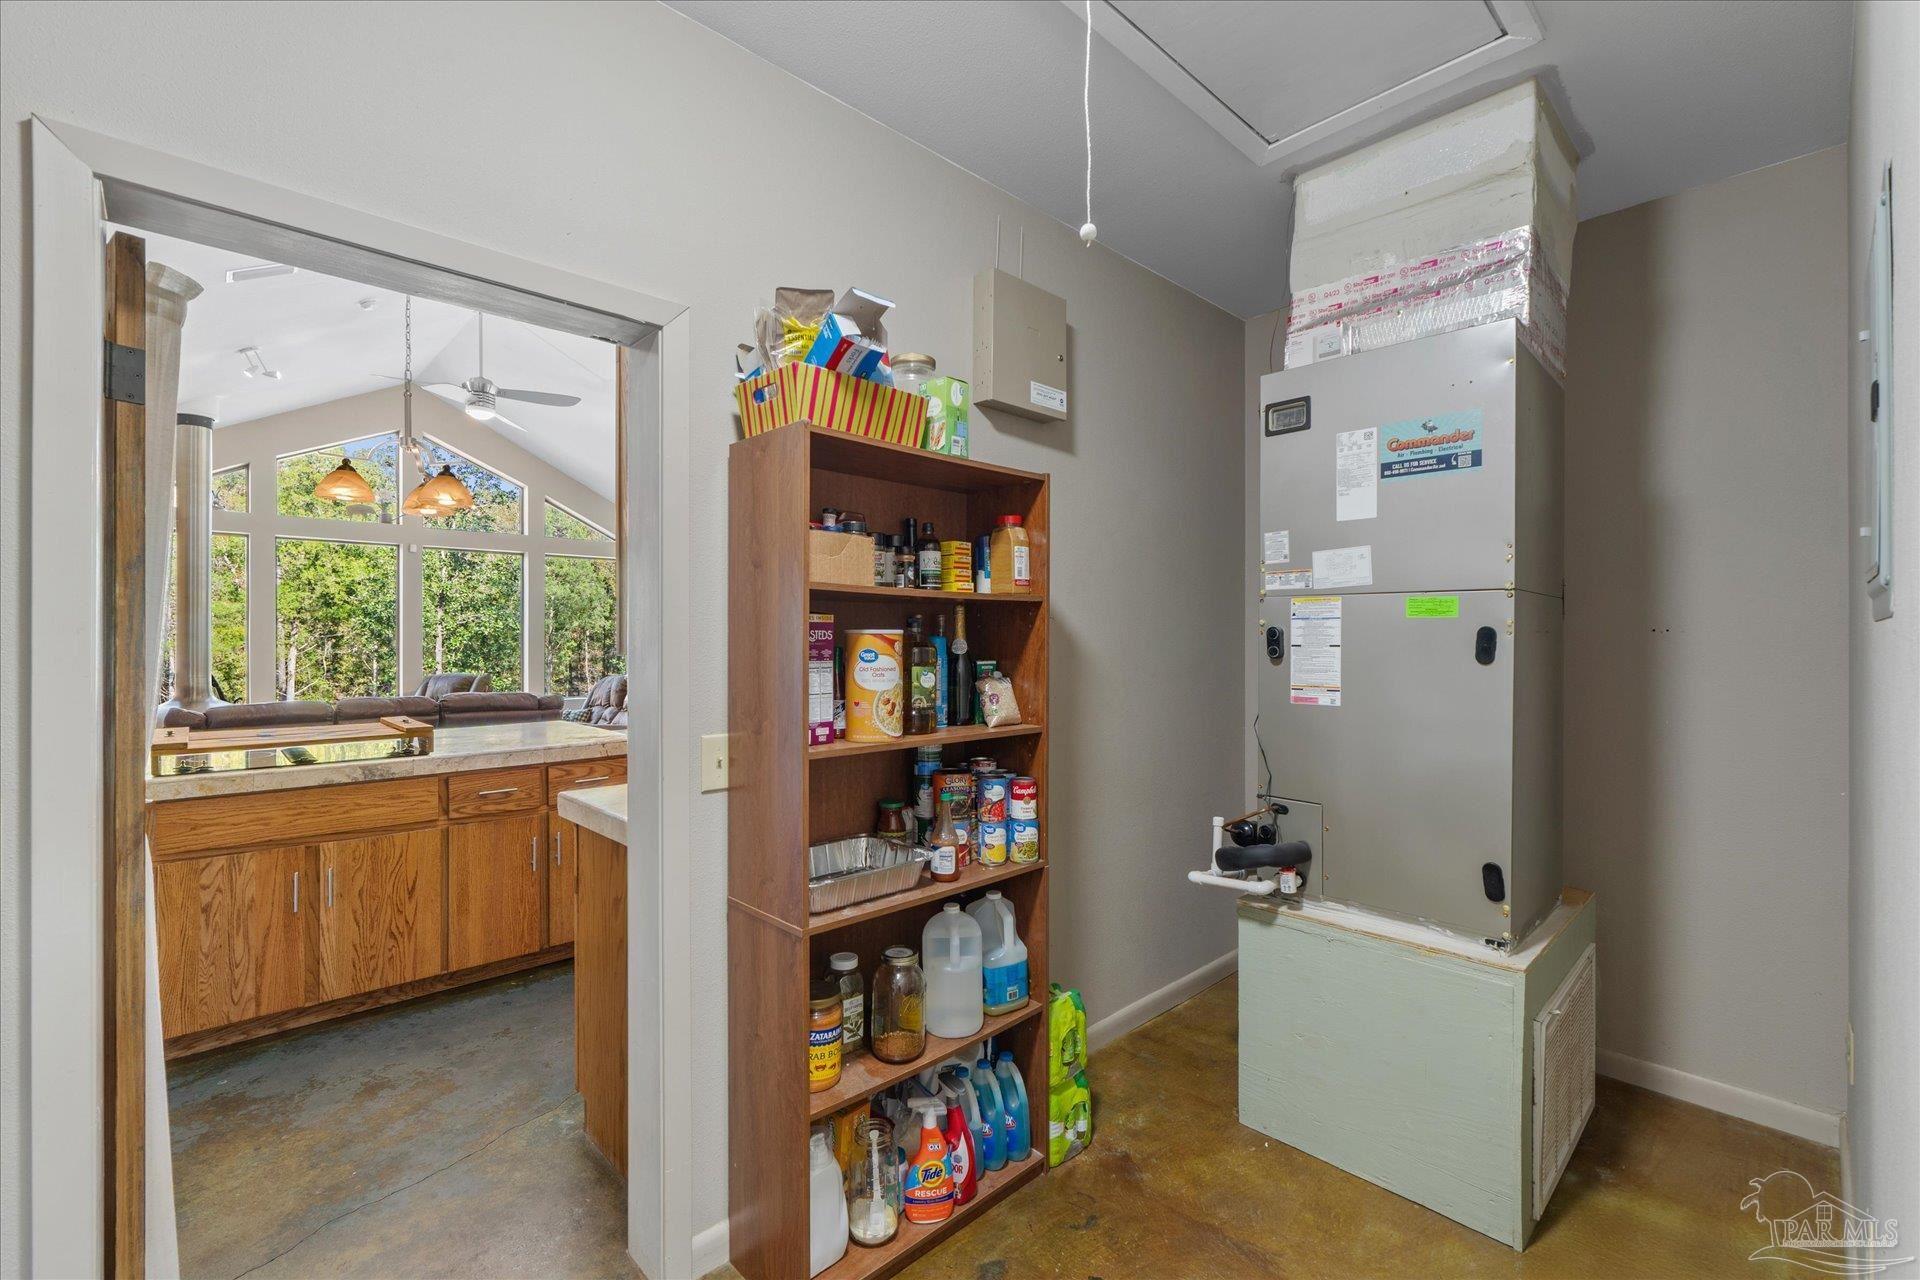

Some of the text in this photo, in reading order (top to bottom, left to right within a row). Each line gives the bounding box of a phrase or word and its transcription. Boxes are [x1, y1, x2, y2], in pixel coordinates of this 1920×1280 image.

[1387, 428, 1475, 452] Commander
[1409, 448, 1433, 456] Plumbing
[1438, 443, 1463, 452] Electrical
[809, 629, 833, 642] STEDS
[808, 1051, 826, 1060] RAB
[922, 1167, 943, 1183] Tide
[914, 1186, 948, 1198] RESCUE
